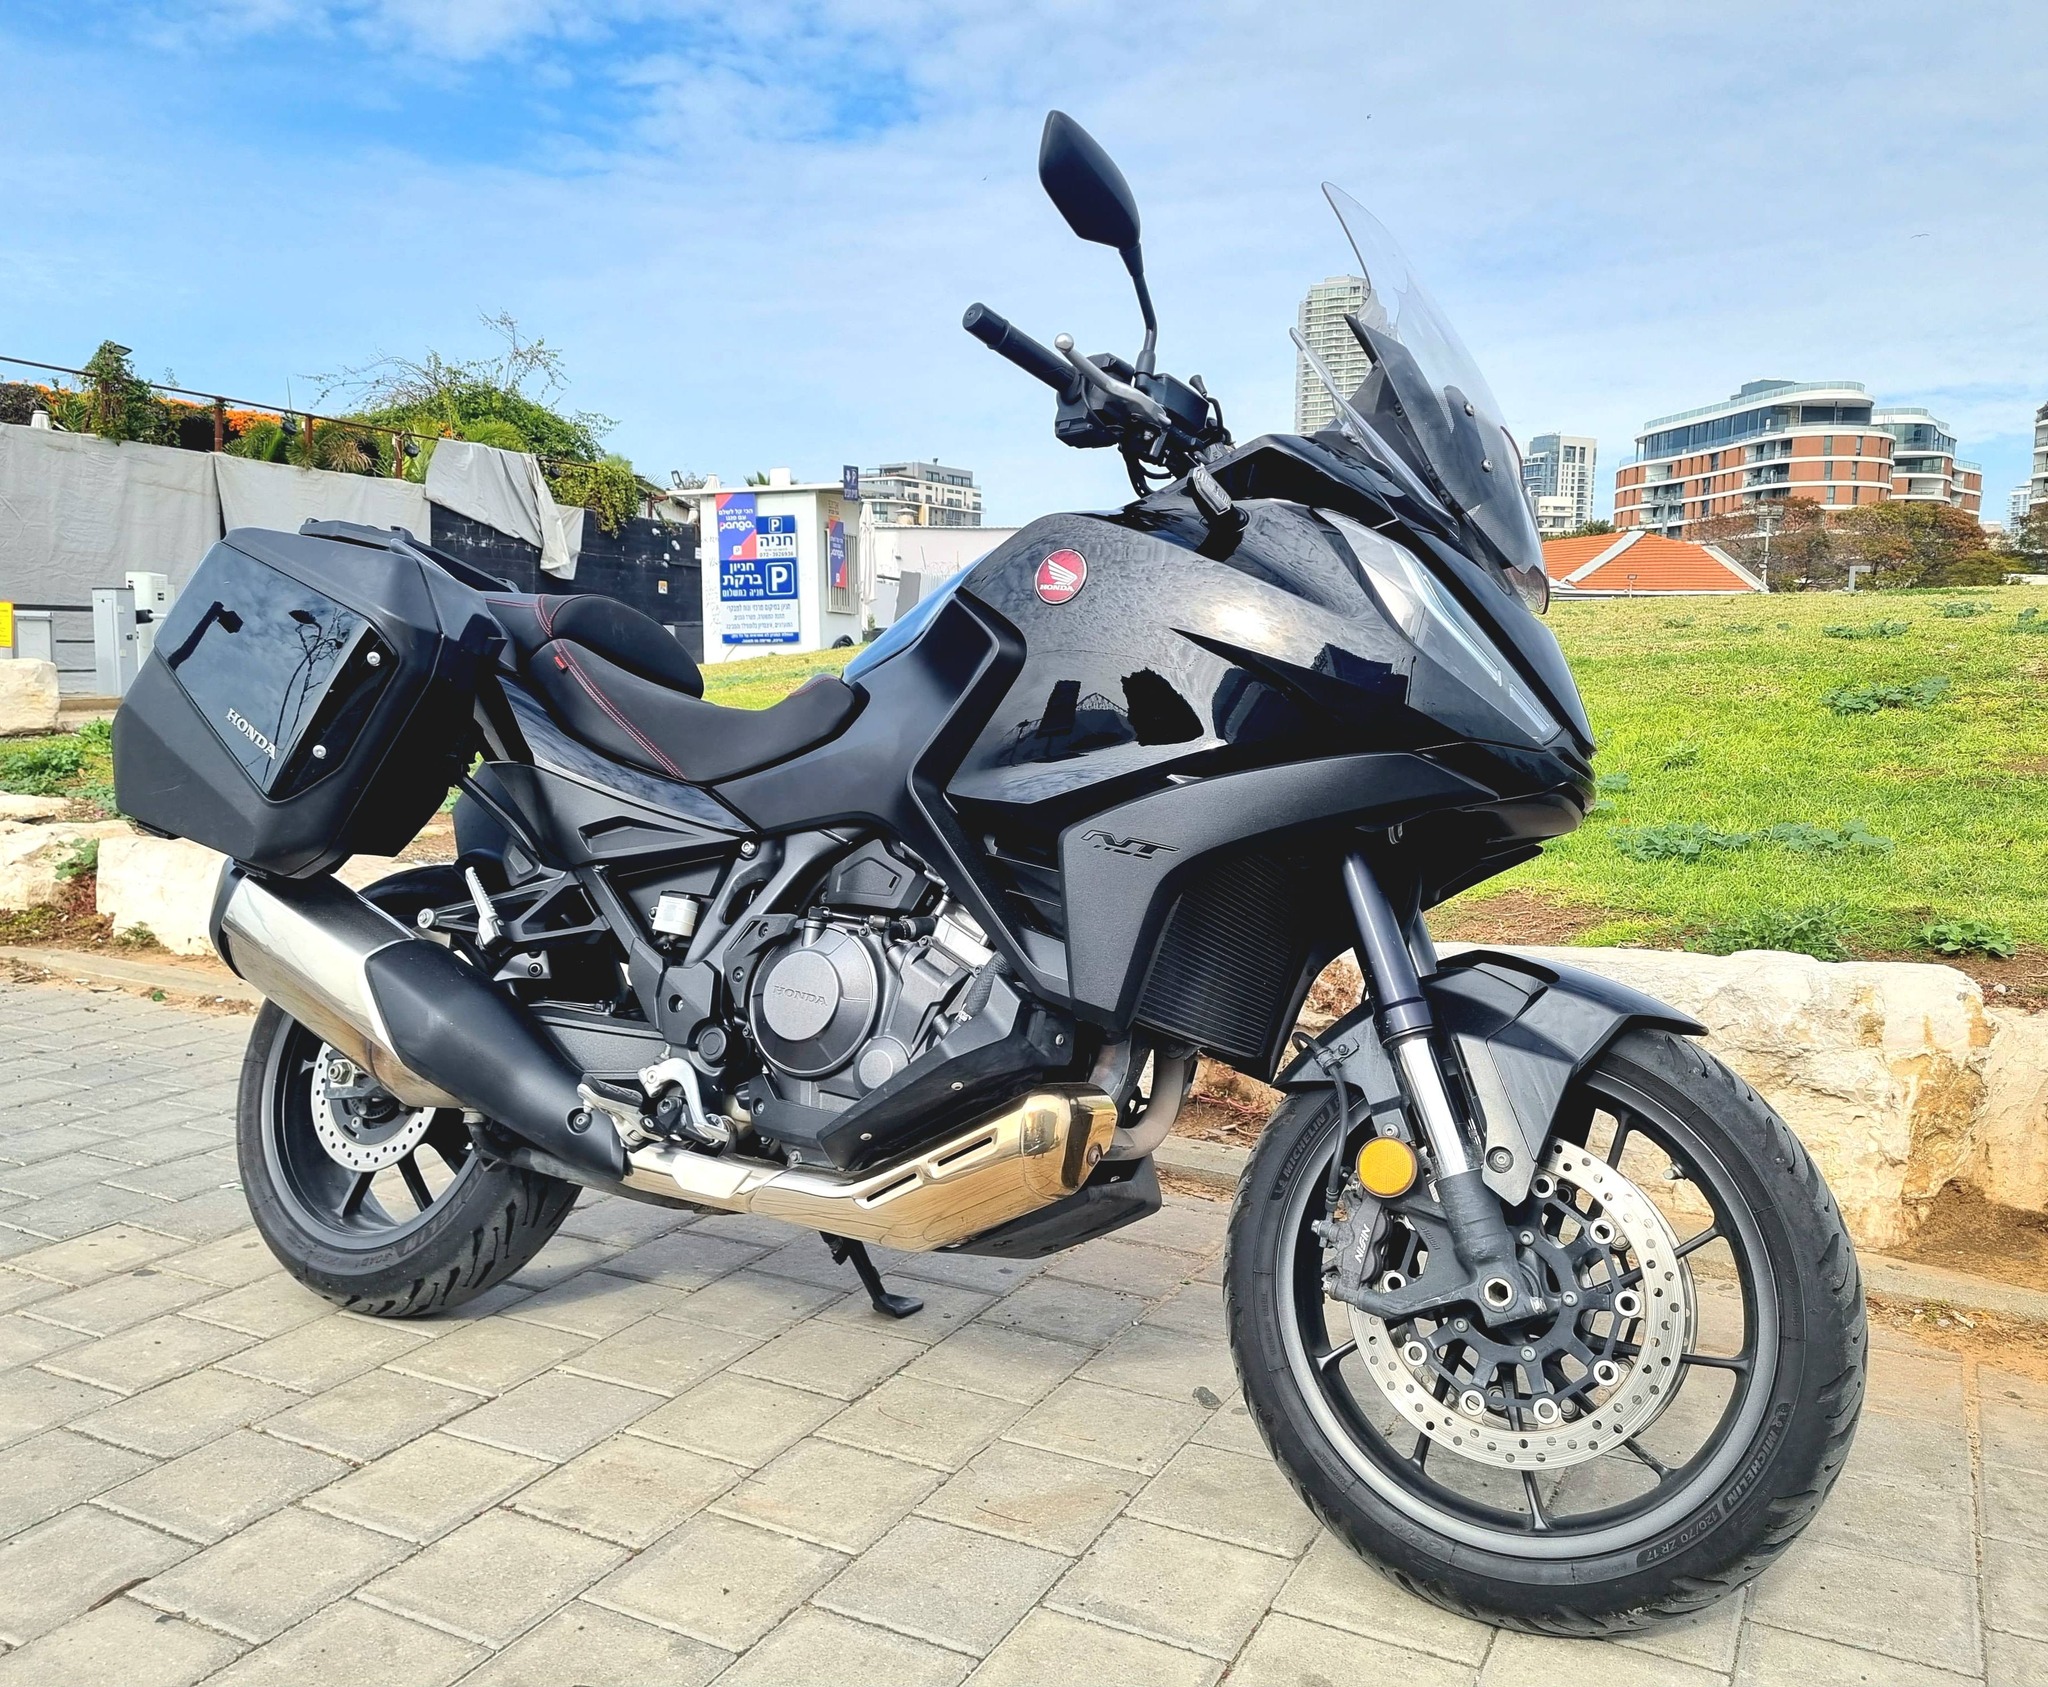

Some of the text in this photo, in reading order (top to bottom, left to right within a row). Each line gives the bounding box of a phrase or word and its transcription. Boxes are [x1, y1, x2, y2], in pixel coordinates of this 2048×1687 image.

[771, 519, 780, 532] P
[760, 536, 793, 546] חניה
[730, 562, 754, 574] חניון
[722, 574, 762, 588] ברקת
[771, 566, 788, 591] P
[722, 588, 764, 597] חניה בתשלום
[226, 708, 276, 760] HONDA
[773, 986, 828, 1006] HONDA
[1282, 1113, 1326, 1178] MICHELIN
[1727, 1430, 1780, 1506] MICHELIN
[1680, 1510, 1718, 1543] 120/70
